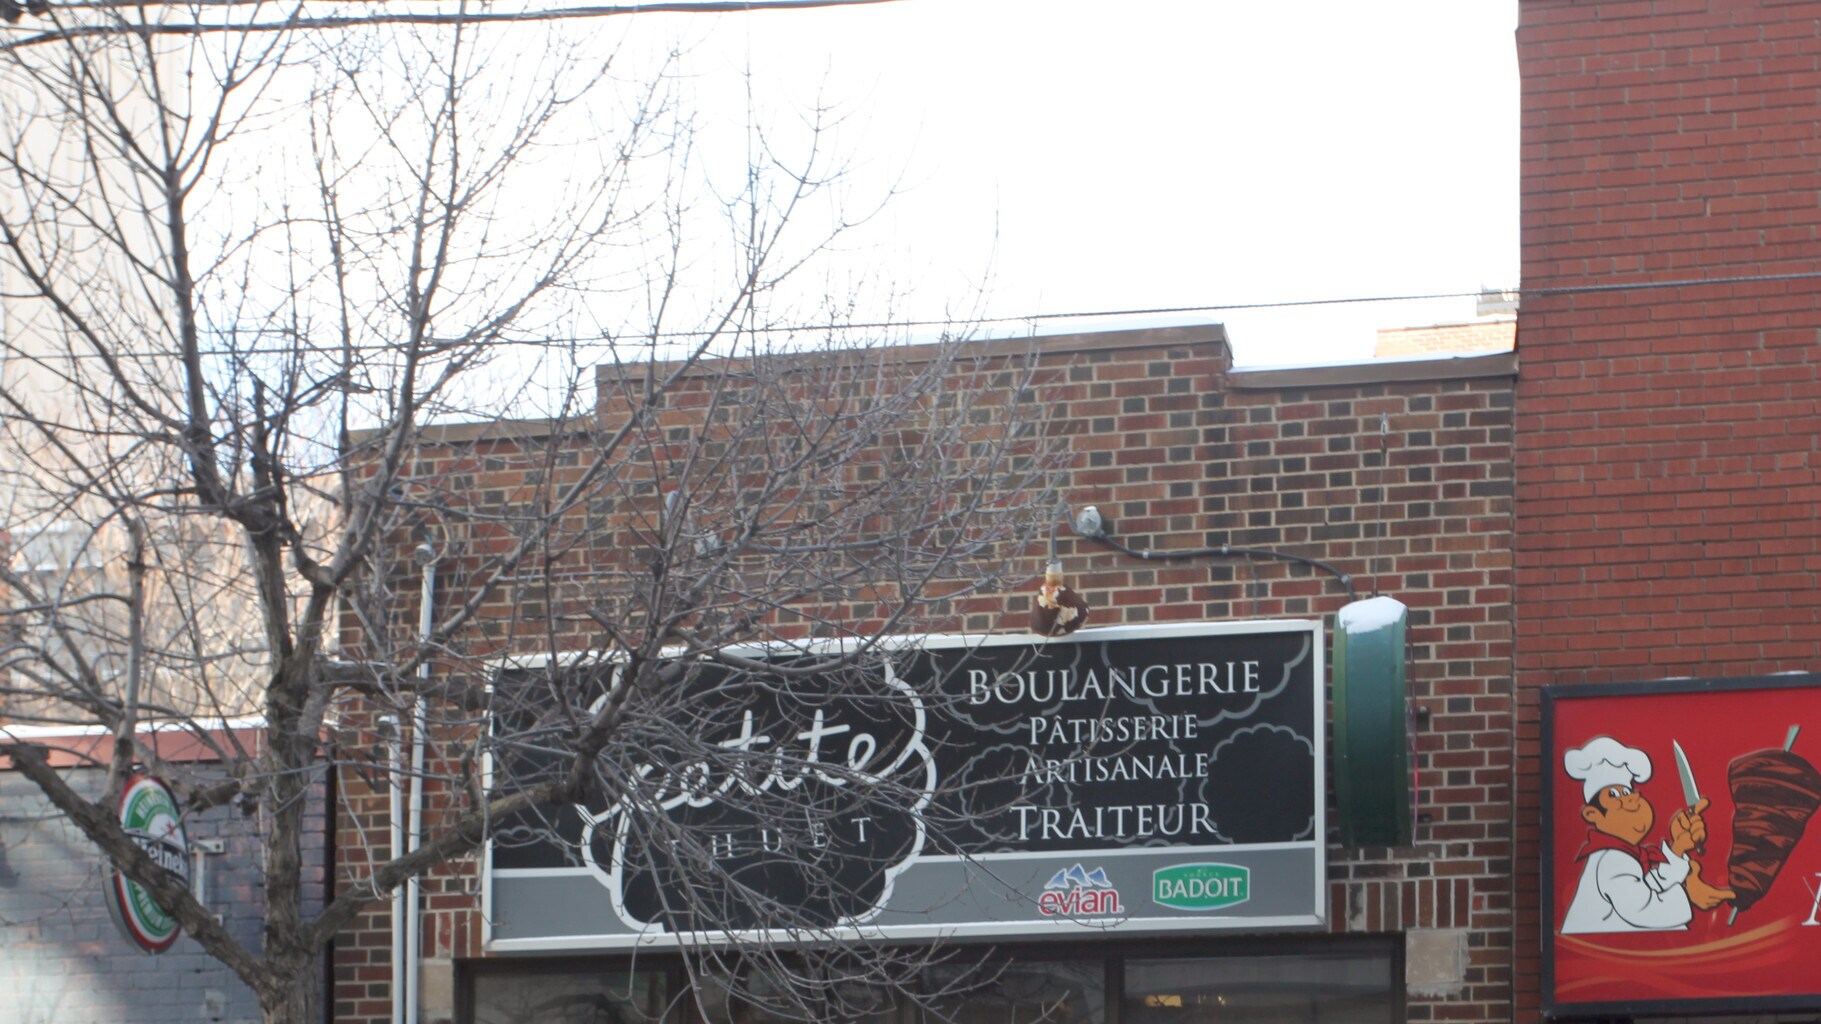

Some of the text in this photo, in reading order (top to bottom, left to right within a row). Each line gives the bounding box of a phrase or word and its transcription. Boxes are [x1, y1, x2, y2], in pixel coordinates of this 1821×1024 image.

[967, 660, 1262, 705] BOULANGERIE
[1028, 714, 1199, 746] PÂTISSERIE
[1018, 753, 1210, 785] ARTISANALE
[1010, 803, 1218, 841] TRAITEUR
[1038, 888, 1119, 916] evian
[1158, 877, 1243, 899] BADOIT
